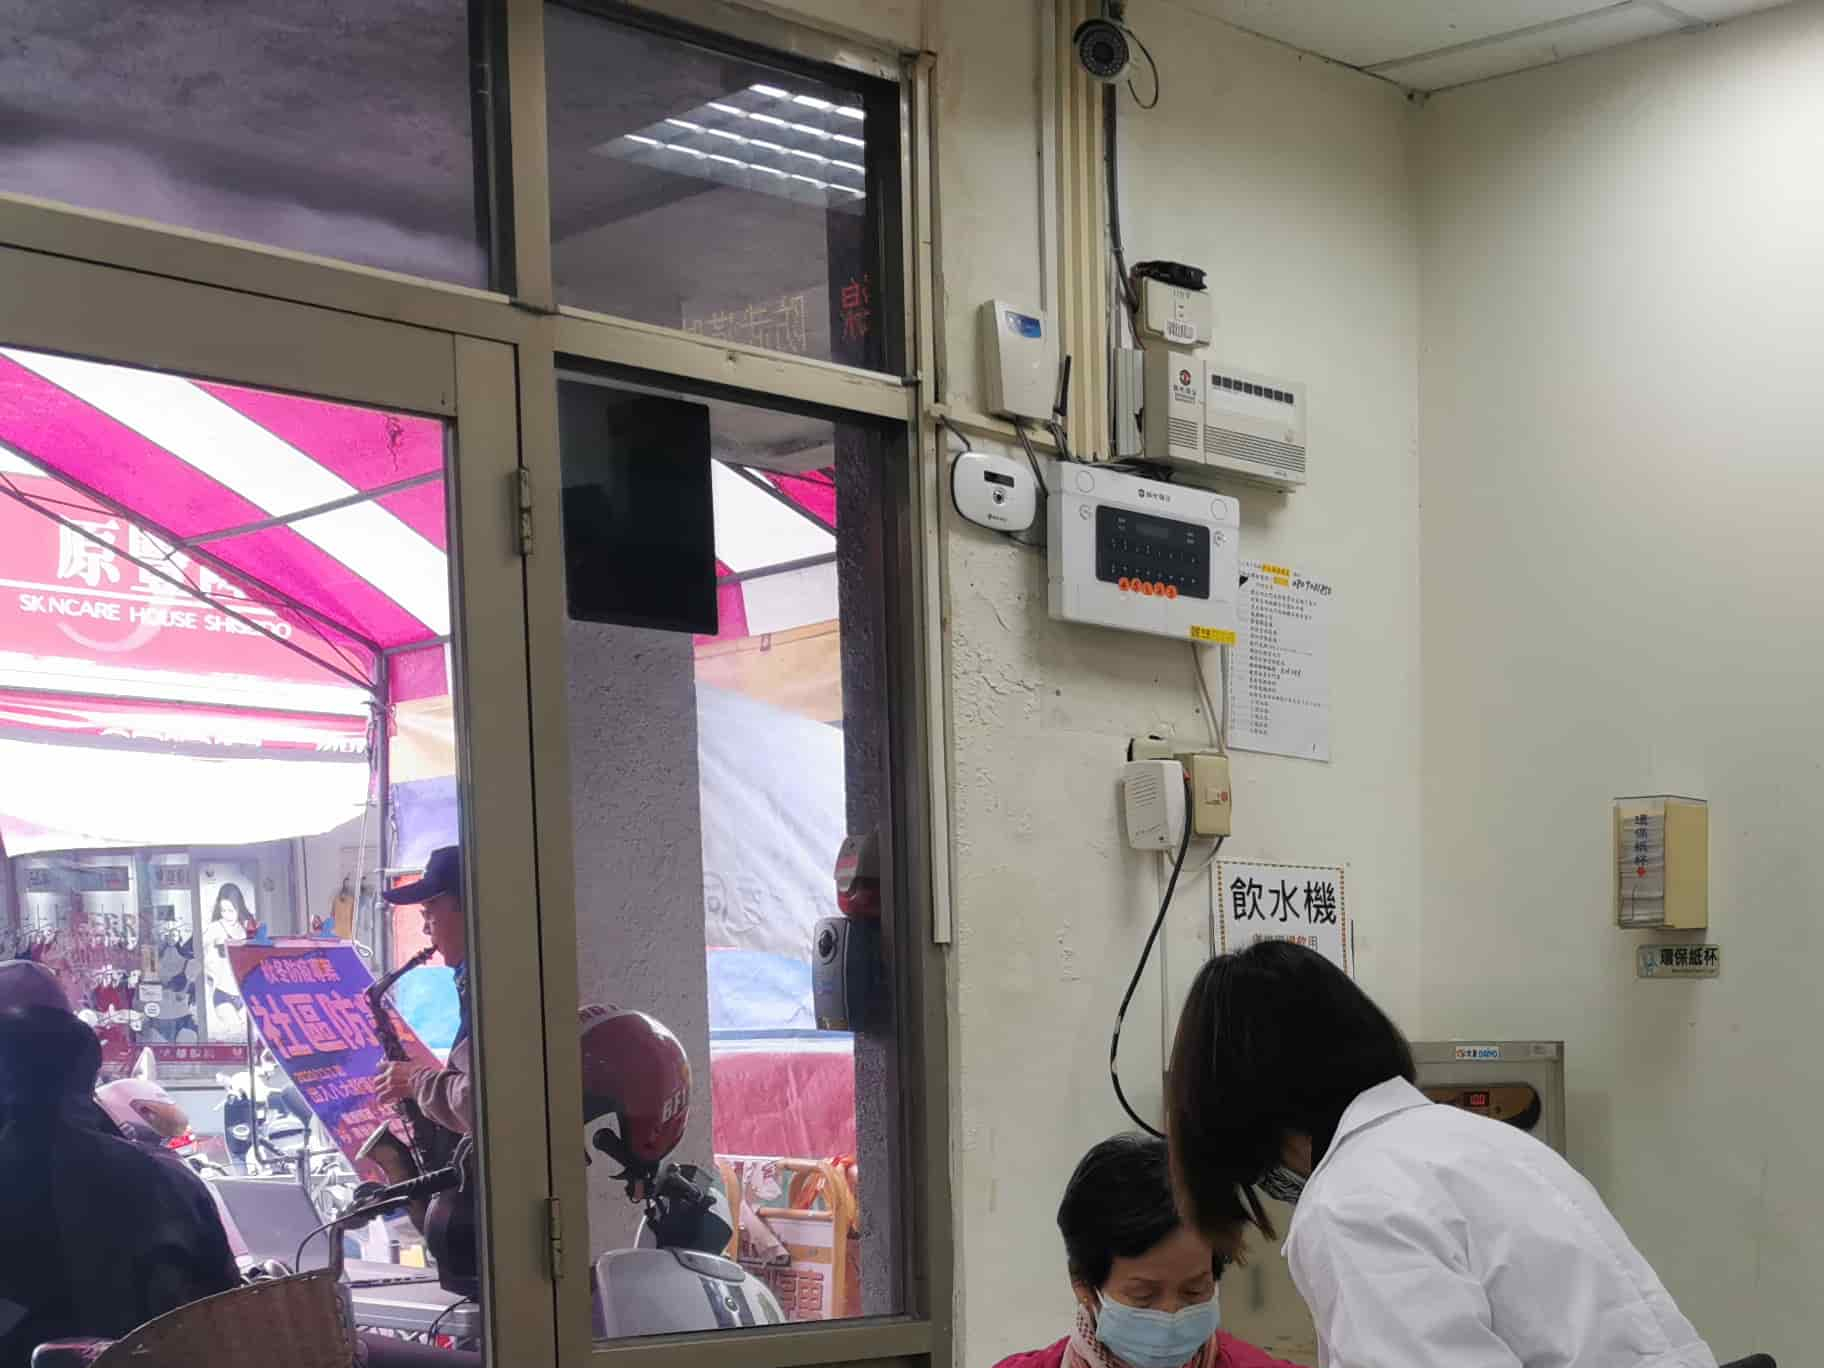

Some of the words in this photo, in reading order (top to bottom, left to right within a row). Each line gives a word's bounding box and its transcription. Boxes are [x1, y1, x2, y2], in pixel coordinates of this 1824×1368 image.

[130, 606, 197, 630] HOUSE
[1230, 876, 1337, 925] 飲水機
[1660, 947, 1719, 967] 環保紙杯
